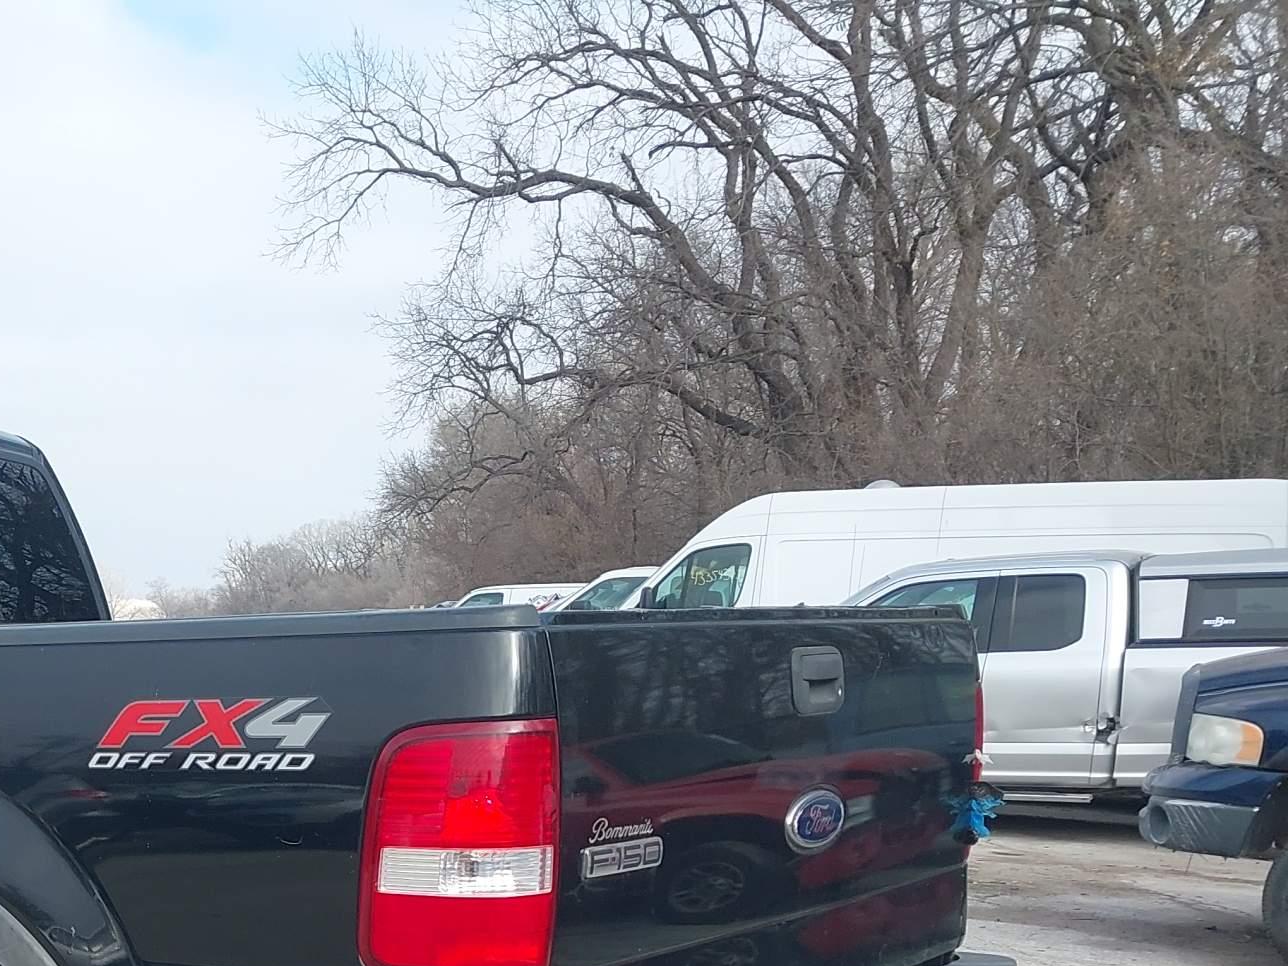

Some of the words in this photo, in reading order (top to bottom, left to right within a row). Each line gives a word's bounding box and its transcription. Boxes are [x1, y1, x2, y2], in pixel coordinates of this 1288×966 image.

[97, 697, 331, 748] FX4
[88, 752, 172, 769] OFF
[179, 753, 315, 770] ROAD
[805, 803, 836, 835] Ford
